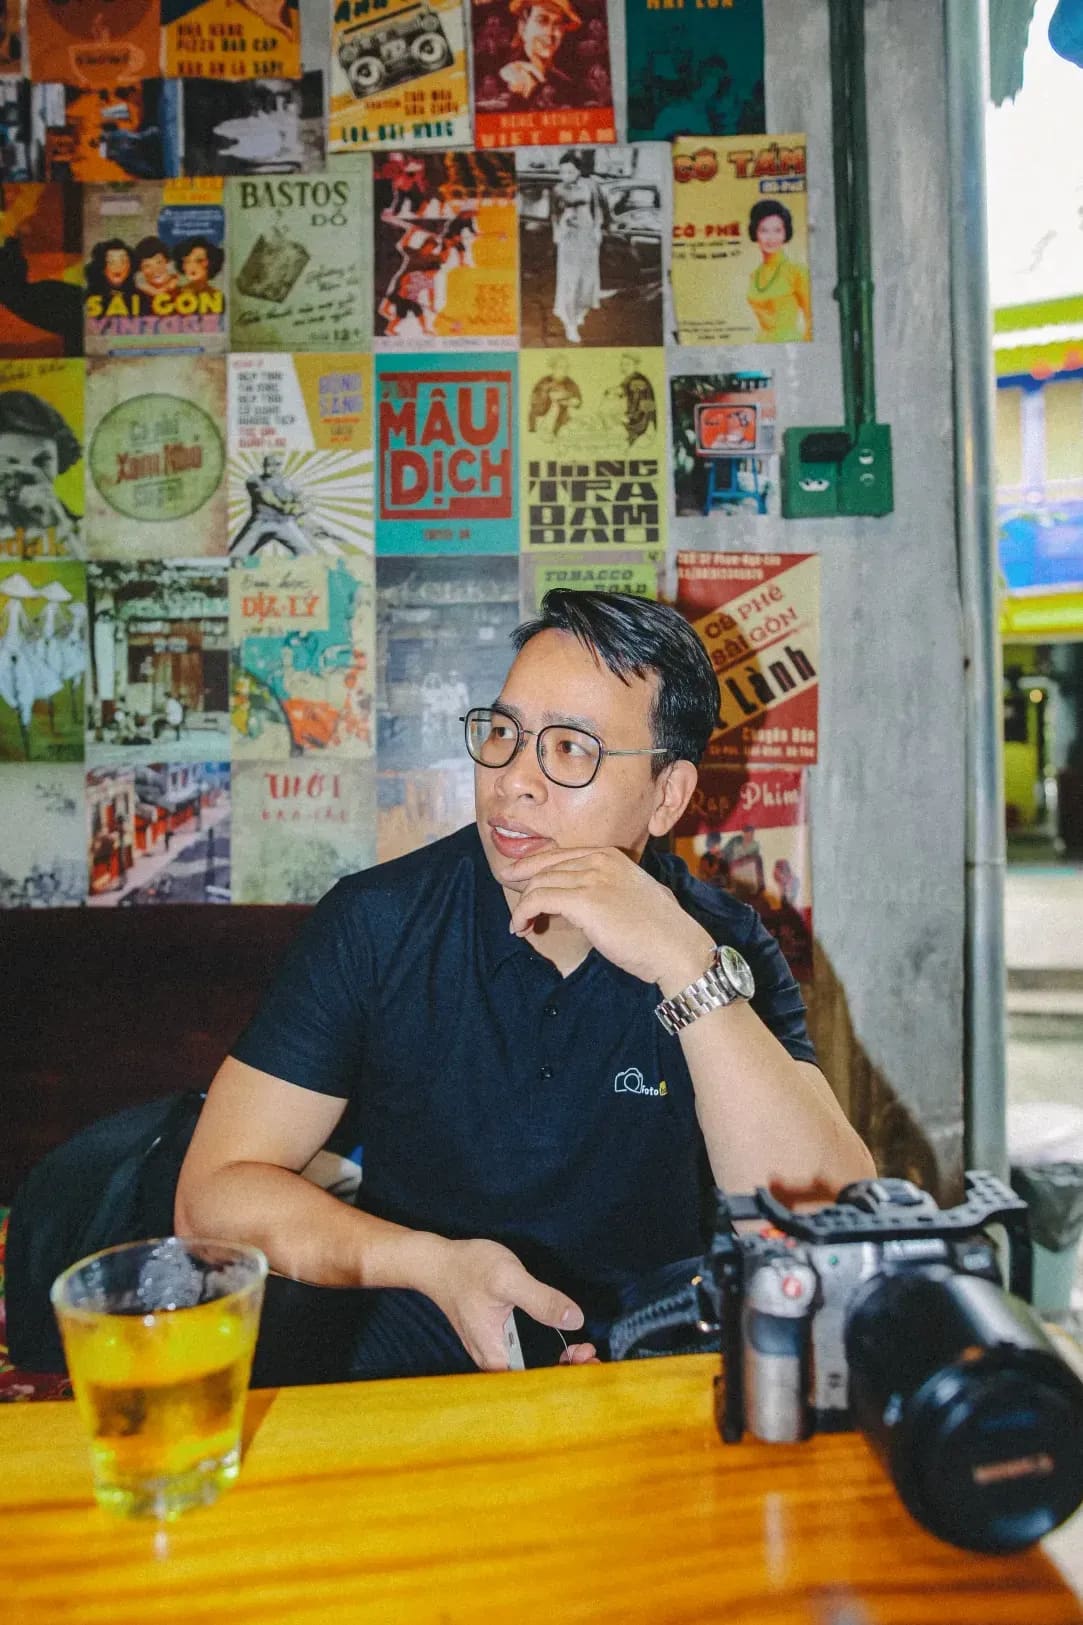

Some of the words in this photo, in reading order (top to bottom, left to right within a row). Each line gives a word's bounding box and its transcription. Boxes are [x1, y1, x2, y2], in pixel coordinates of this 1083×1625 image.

[239, 180, 349, 210] BASTOS
[390, 448, 511, 506] DỊCH
[544, 569, 634, 582] TOBACCO
[725, 645, 817, 715] Lành
[740, 781, 799, 811] Phim
